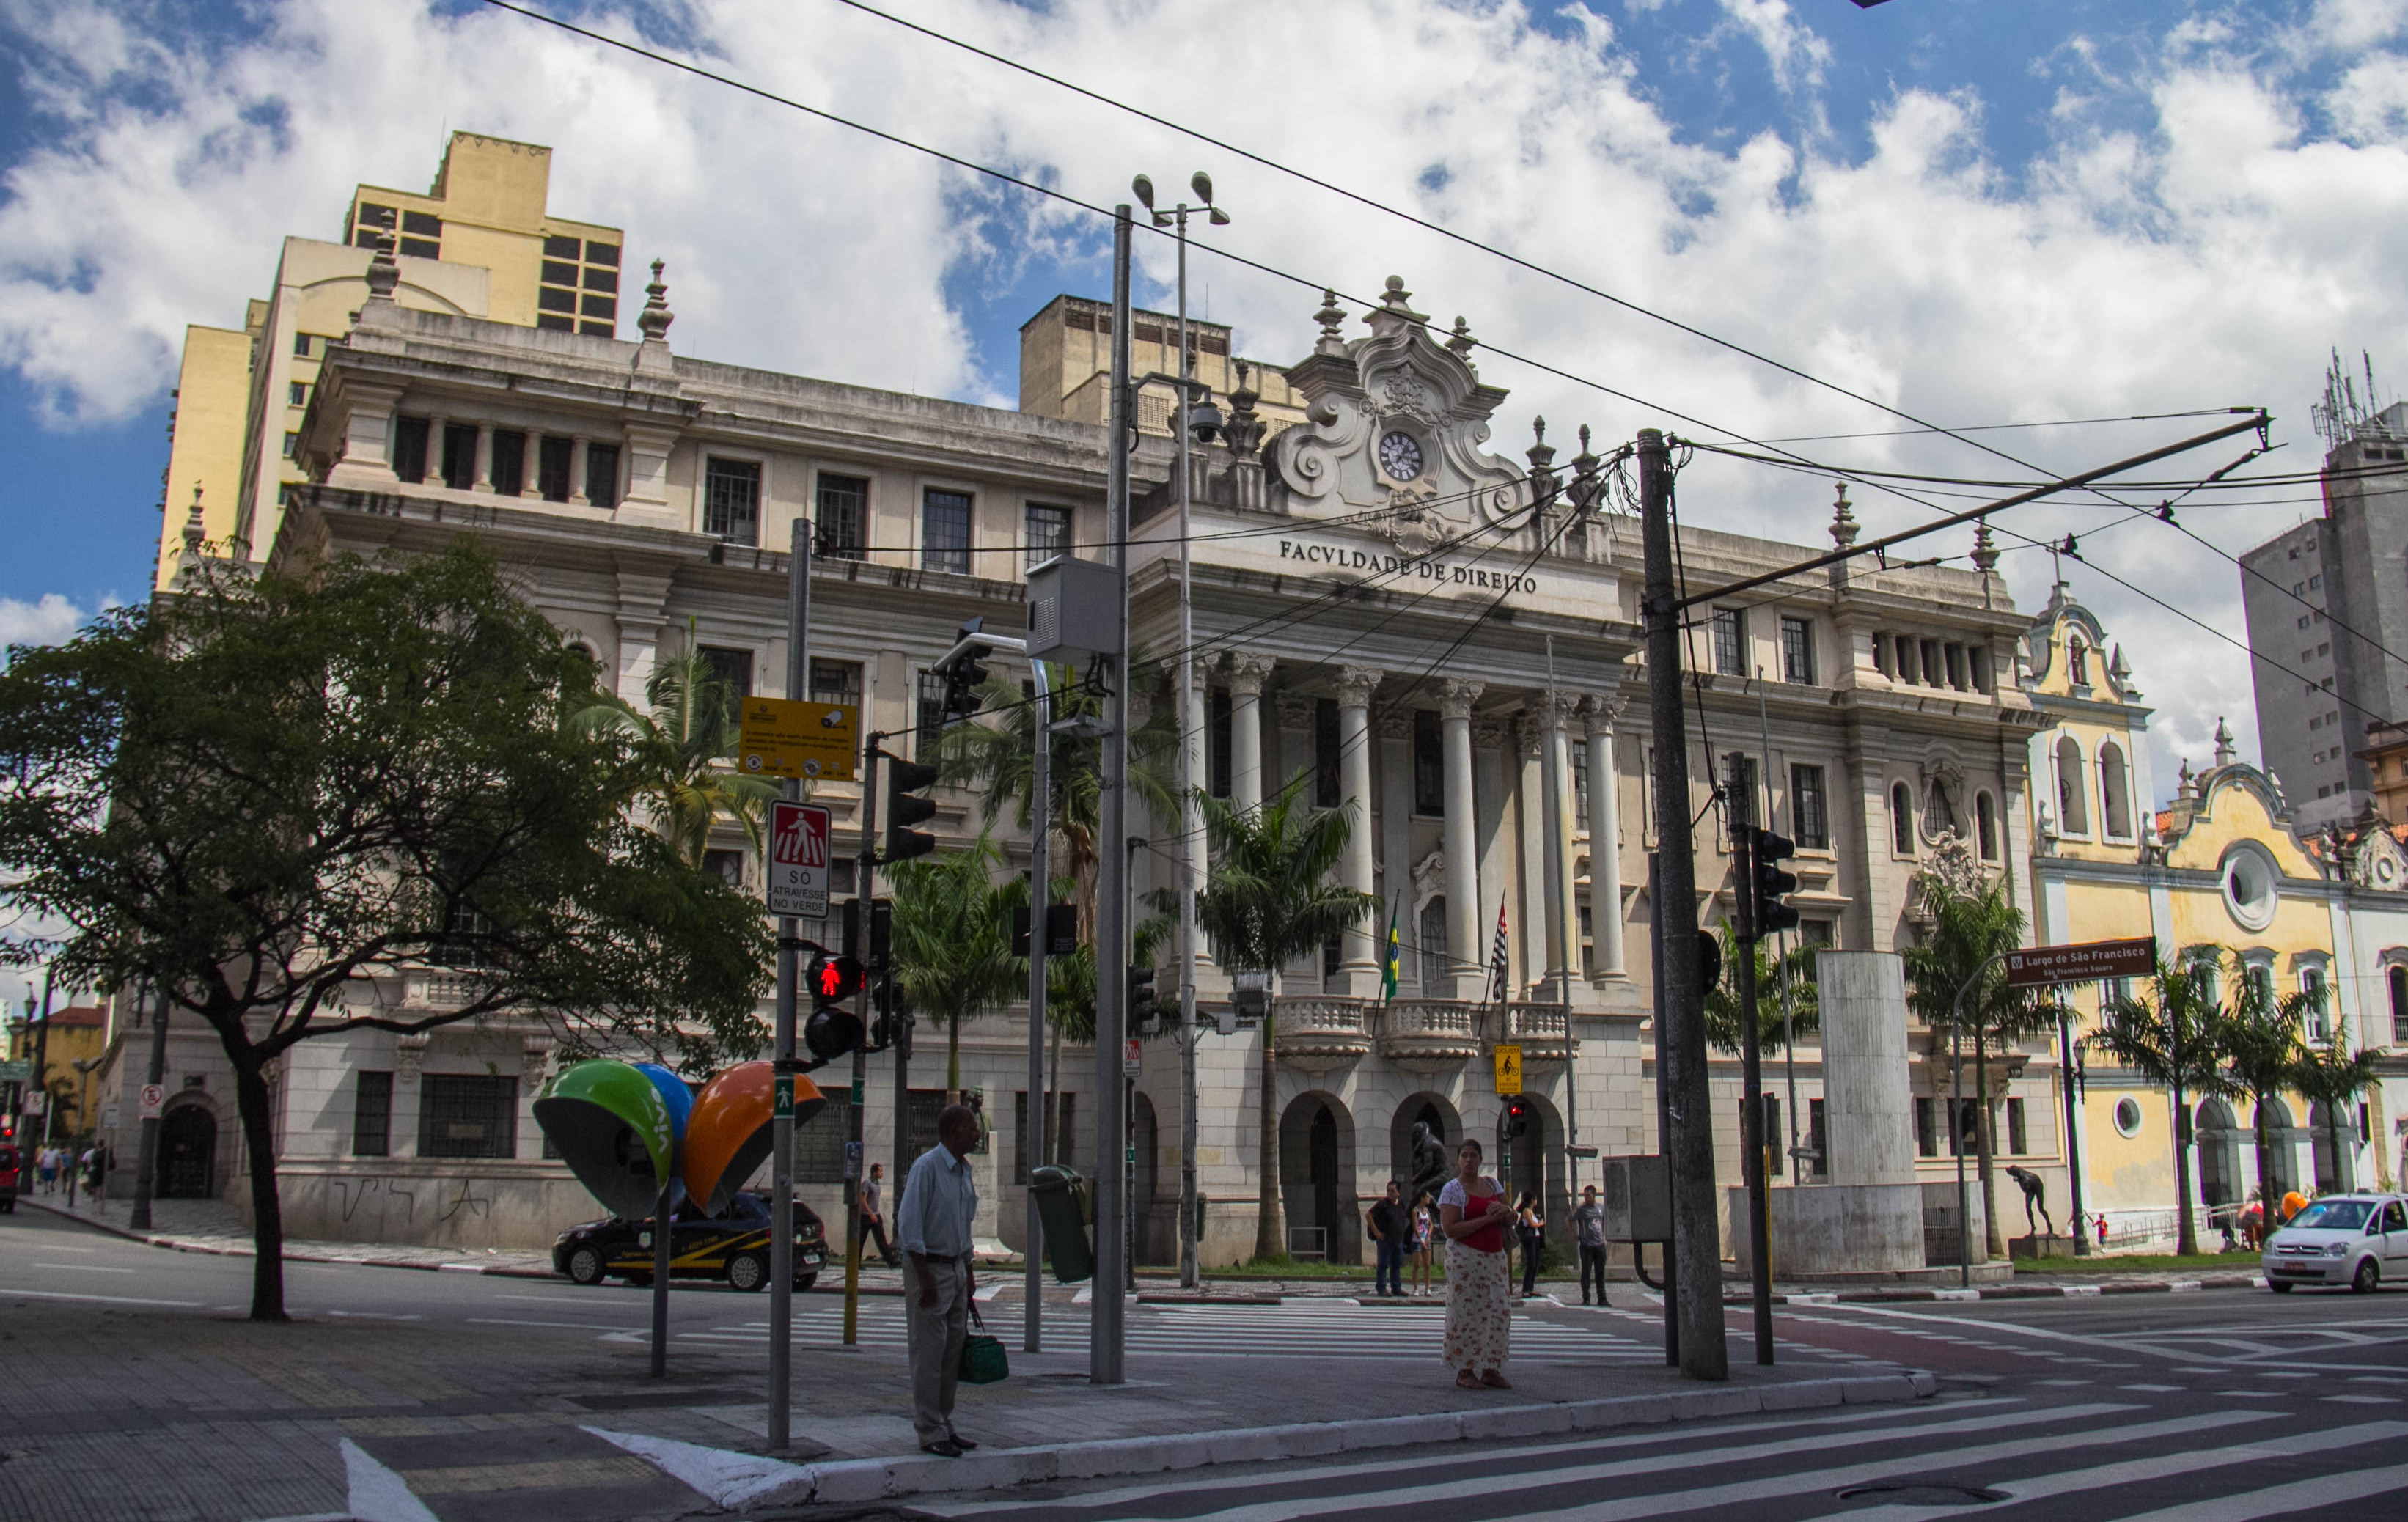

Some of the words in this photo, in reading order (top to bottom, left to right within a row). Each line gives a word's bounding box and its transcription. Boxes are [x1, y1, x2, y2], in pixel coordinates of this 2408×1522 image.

[1280, 540, 1411, 576] FACVLDADE
[1420, 561, 1445, 581] DE
[1453, 567, 1536, 594] DIREITO
[789, 867, 810, 885] SÓ
[773, 886, 826, 900] ATRAVESSE
[774, 898, 788, 908] NO
[793, 900, 824, 912] VERDE
[2026, 956, 2052, 966] Largo
[2055, 955, 2067, 964] de
[2070, 952, 2089, 963] São
[2092, 947, 2145, 960] Francisco
[651, 1087, 668, 1153] vivo
